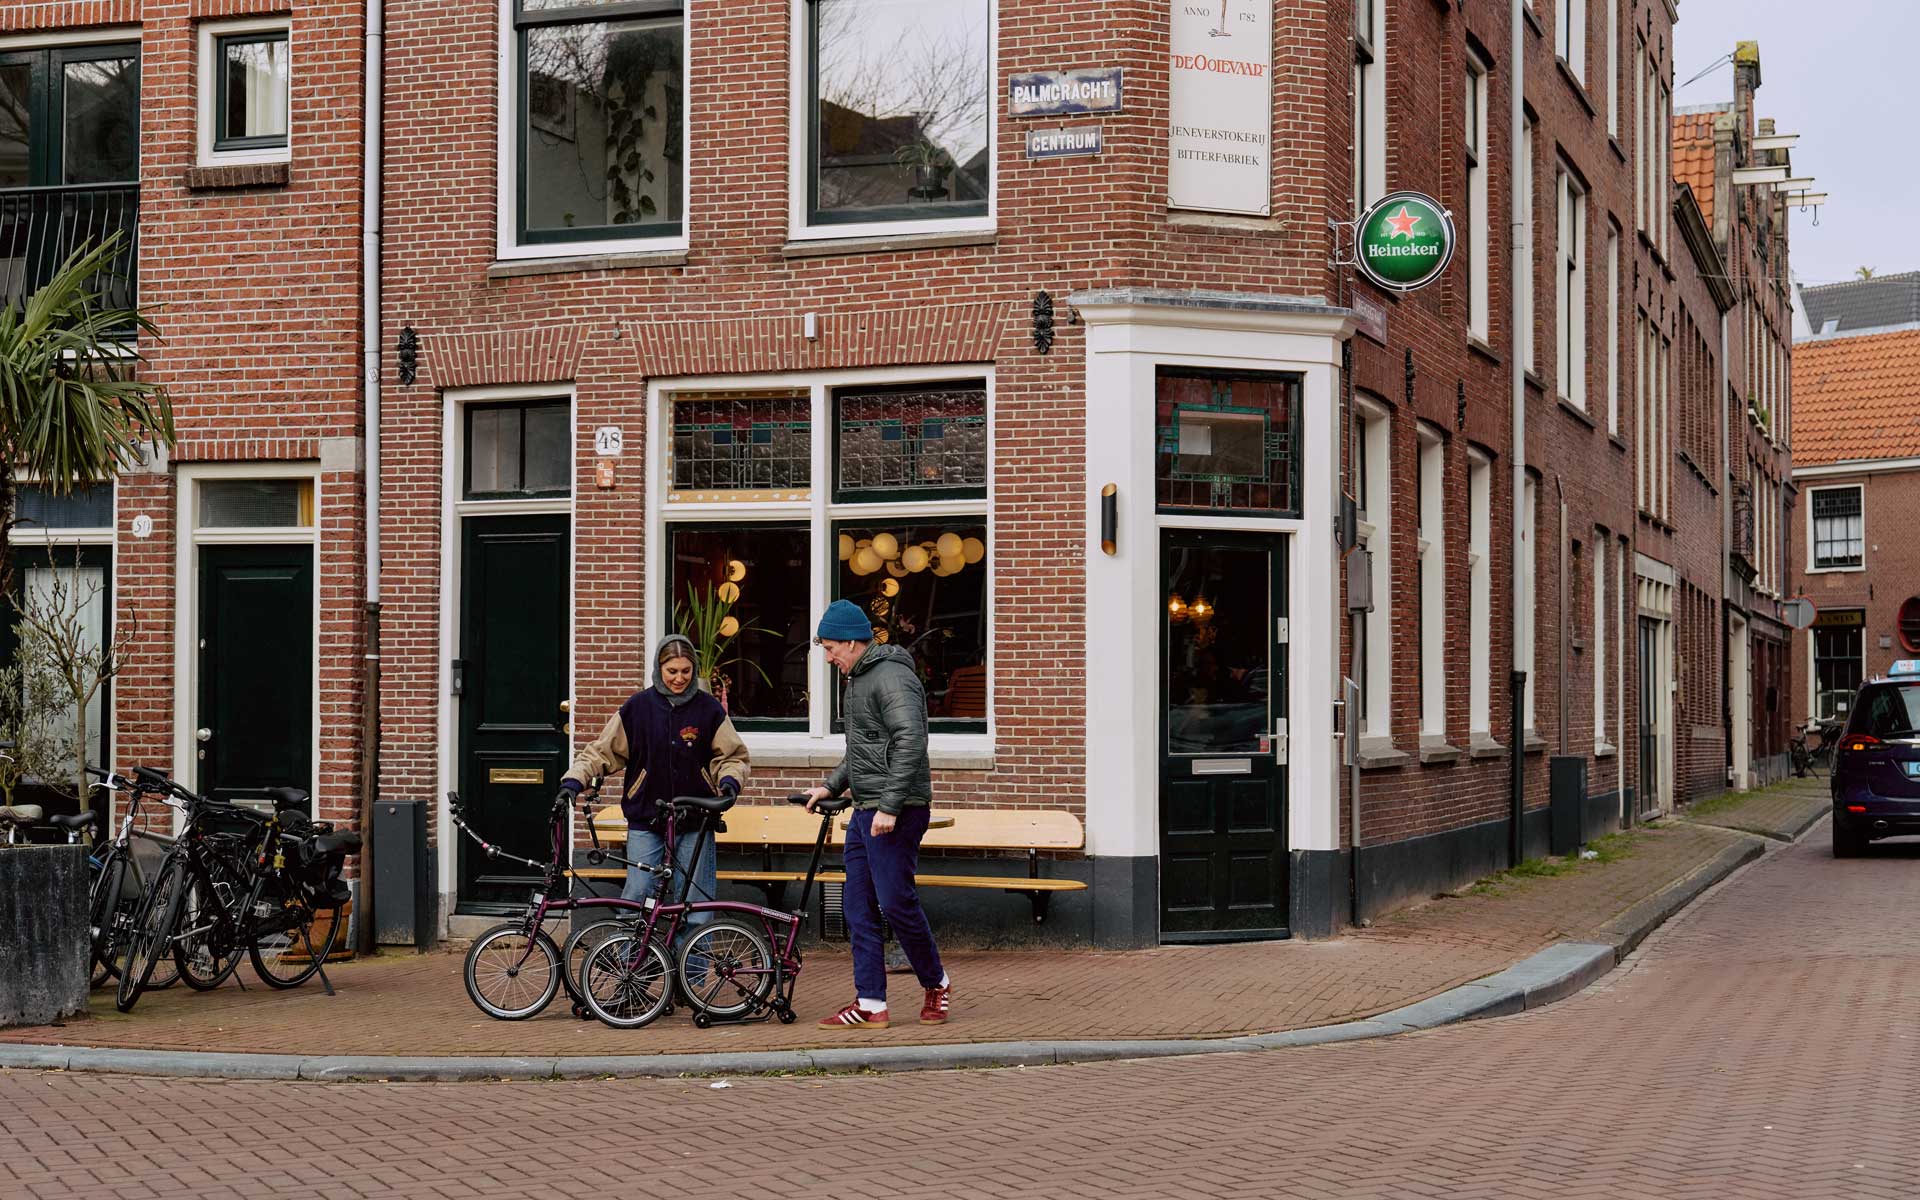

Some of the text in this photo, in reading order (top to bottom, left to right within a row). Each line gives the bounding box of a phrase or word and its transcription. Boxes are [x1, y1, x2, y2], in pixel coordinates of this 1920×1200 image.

[1183, 6, 1256, 22] ANNO 1782
[1031, 132, 1096, 152] CENTRUM
[1168, 125, 1266, 146] JENEVERSTOKERIJ
[1177, 149, 1260, 166] BITTERFABRIEK
[1368, 242, 1439, 257] Heineken
[598, 431, 621, 449] 48
